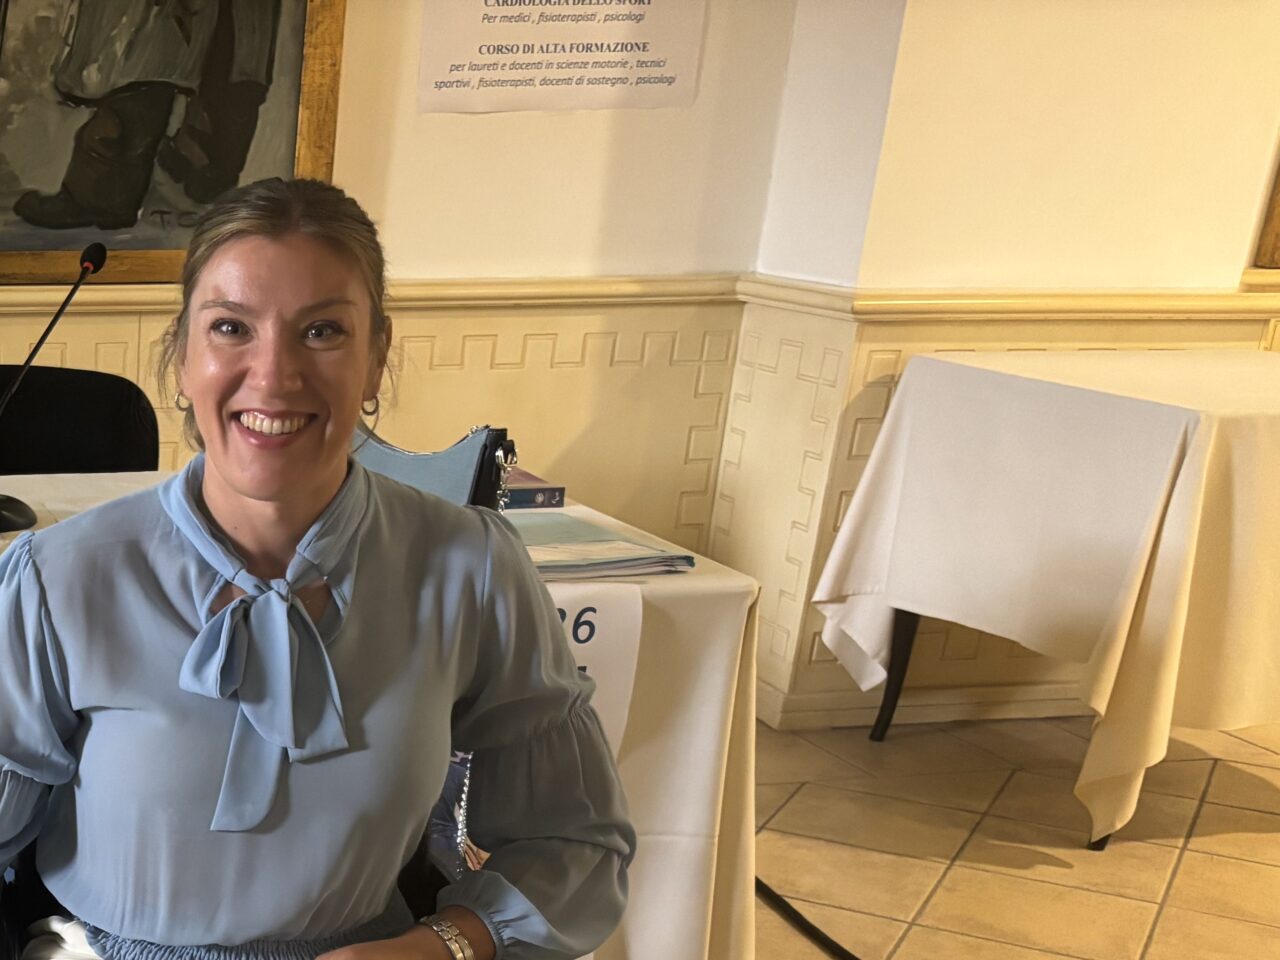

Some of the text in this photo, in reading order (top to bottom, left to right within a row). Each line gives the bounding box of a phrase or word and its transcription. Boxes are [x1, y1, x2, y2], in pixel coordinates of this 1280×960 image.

[482, 13, 497, 23] Per
[499, 13, 531, 23] medici
[536, 12, 597, 25] fisioterapisti
[602, 11, 645, 24] psicologi
[478, 42, 650, 55] CORSO DI ALTA FORMAZIONE
[449, 63, 466, 74] per
[468, 61, 499, 71] laureti
[508, 60, 543, 71] docenti
[545, 60, 554, 70] in
[555, 59, 589, 70] scienze
[591, 58, 629, 69] motorie
[636, 57, 667, 68] tecnici
[433, 78, 470, 90] sportivi
[539, 75, 573, 86] docenti
[575, 74, 585, 86] di
[586, 74, 629, 87] sostegno
[635, 73, 676, 86] psicologi
